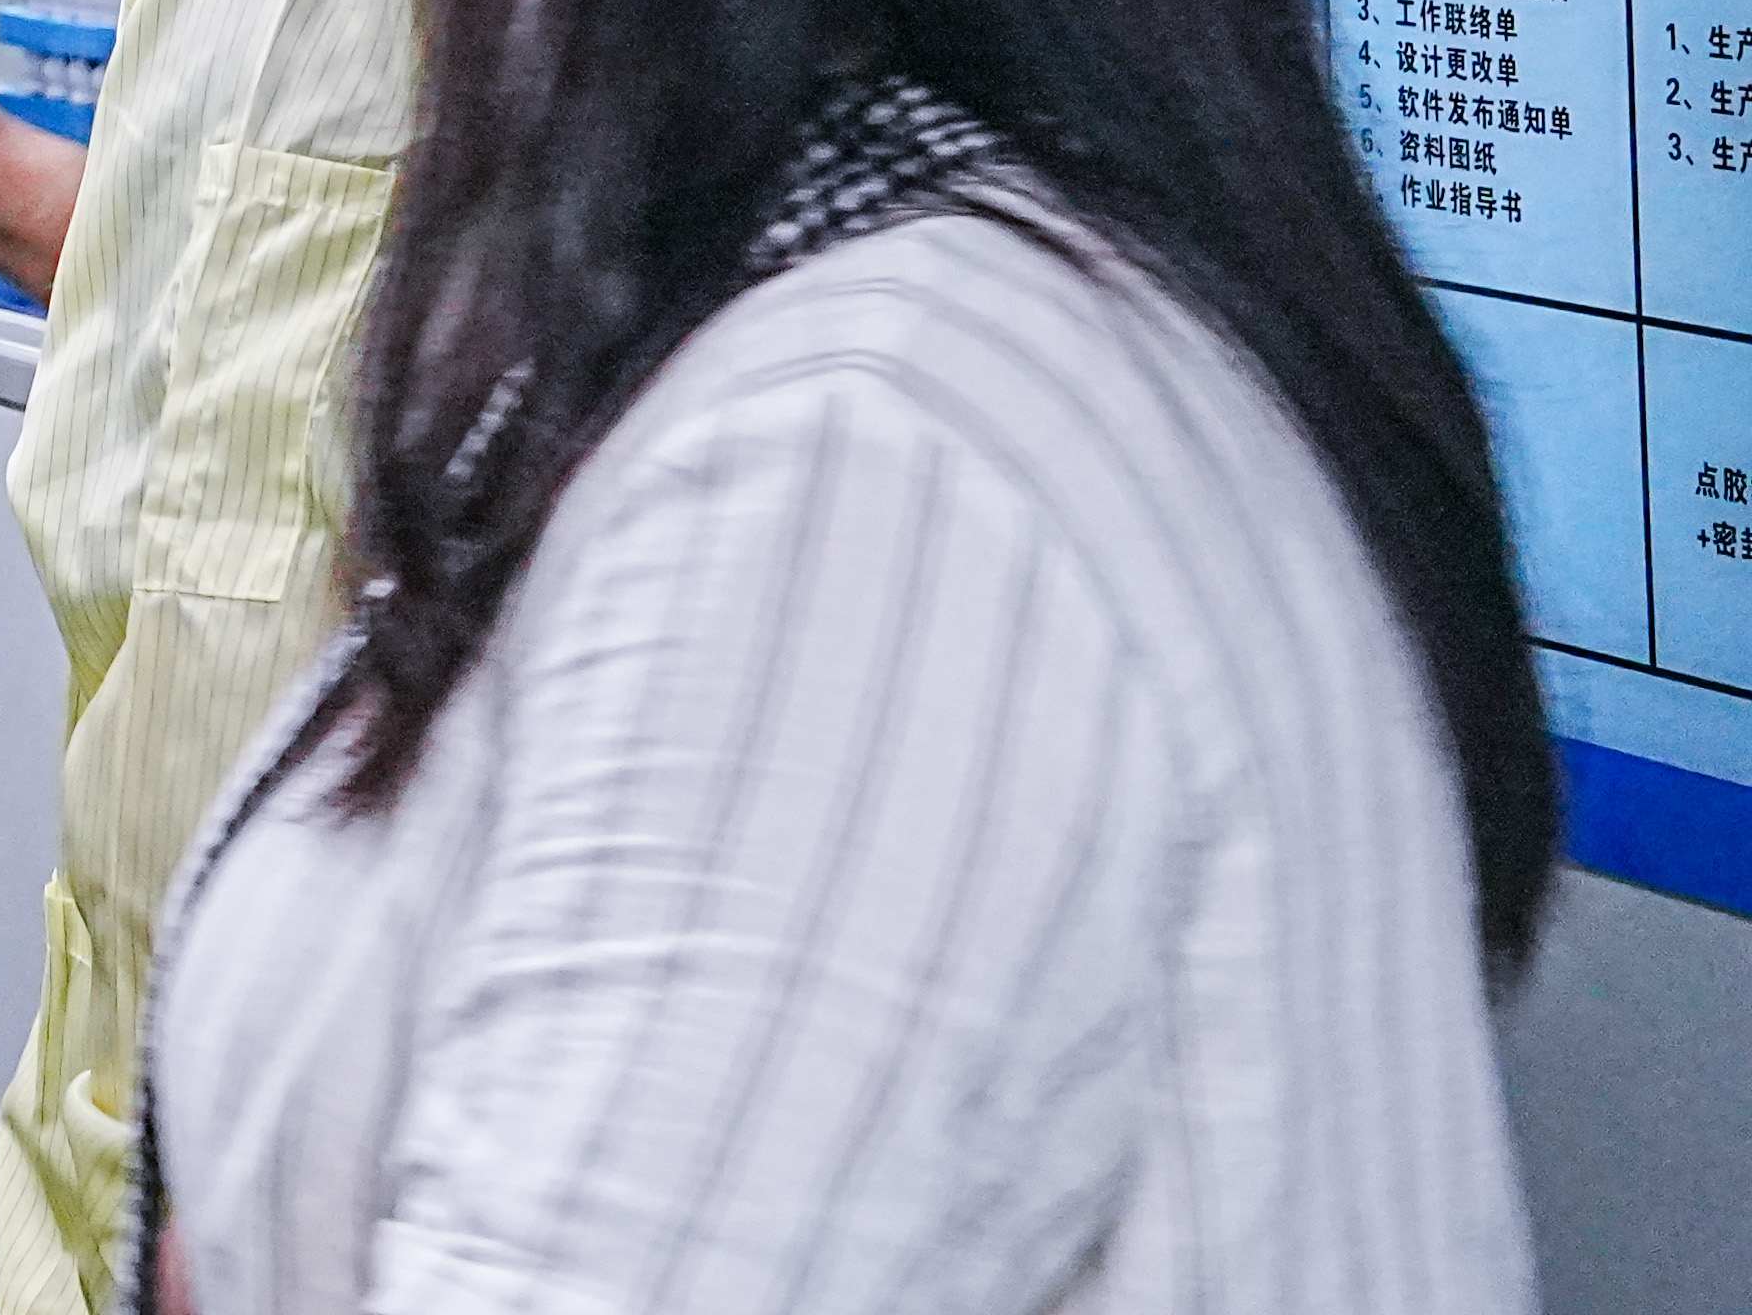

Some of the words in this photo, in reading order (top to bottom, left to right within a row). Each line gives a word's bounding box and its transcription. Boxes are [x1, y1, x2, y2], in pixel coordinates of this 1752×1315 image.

[1358, 39, 1519, 88] 4、设计更改单
[1358, 83, 1573, 140] 5、软件发布通知单
[1695, 461, 1752, 506] 点胶
